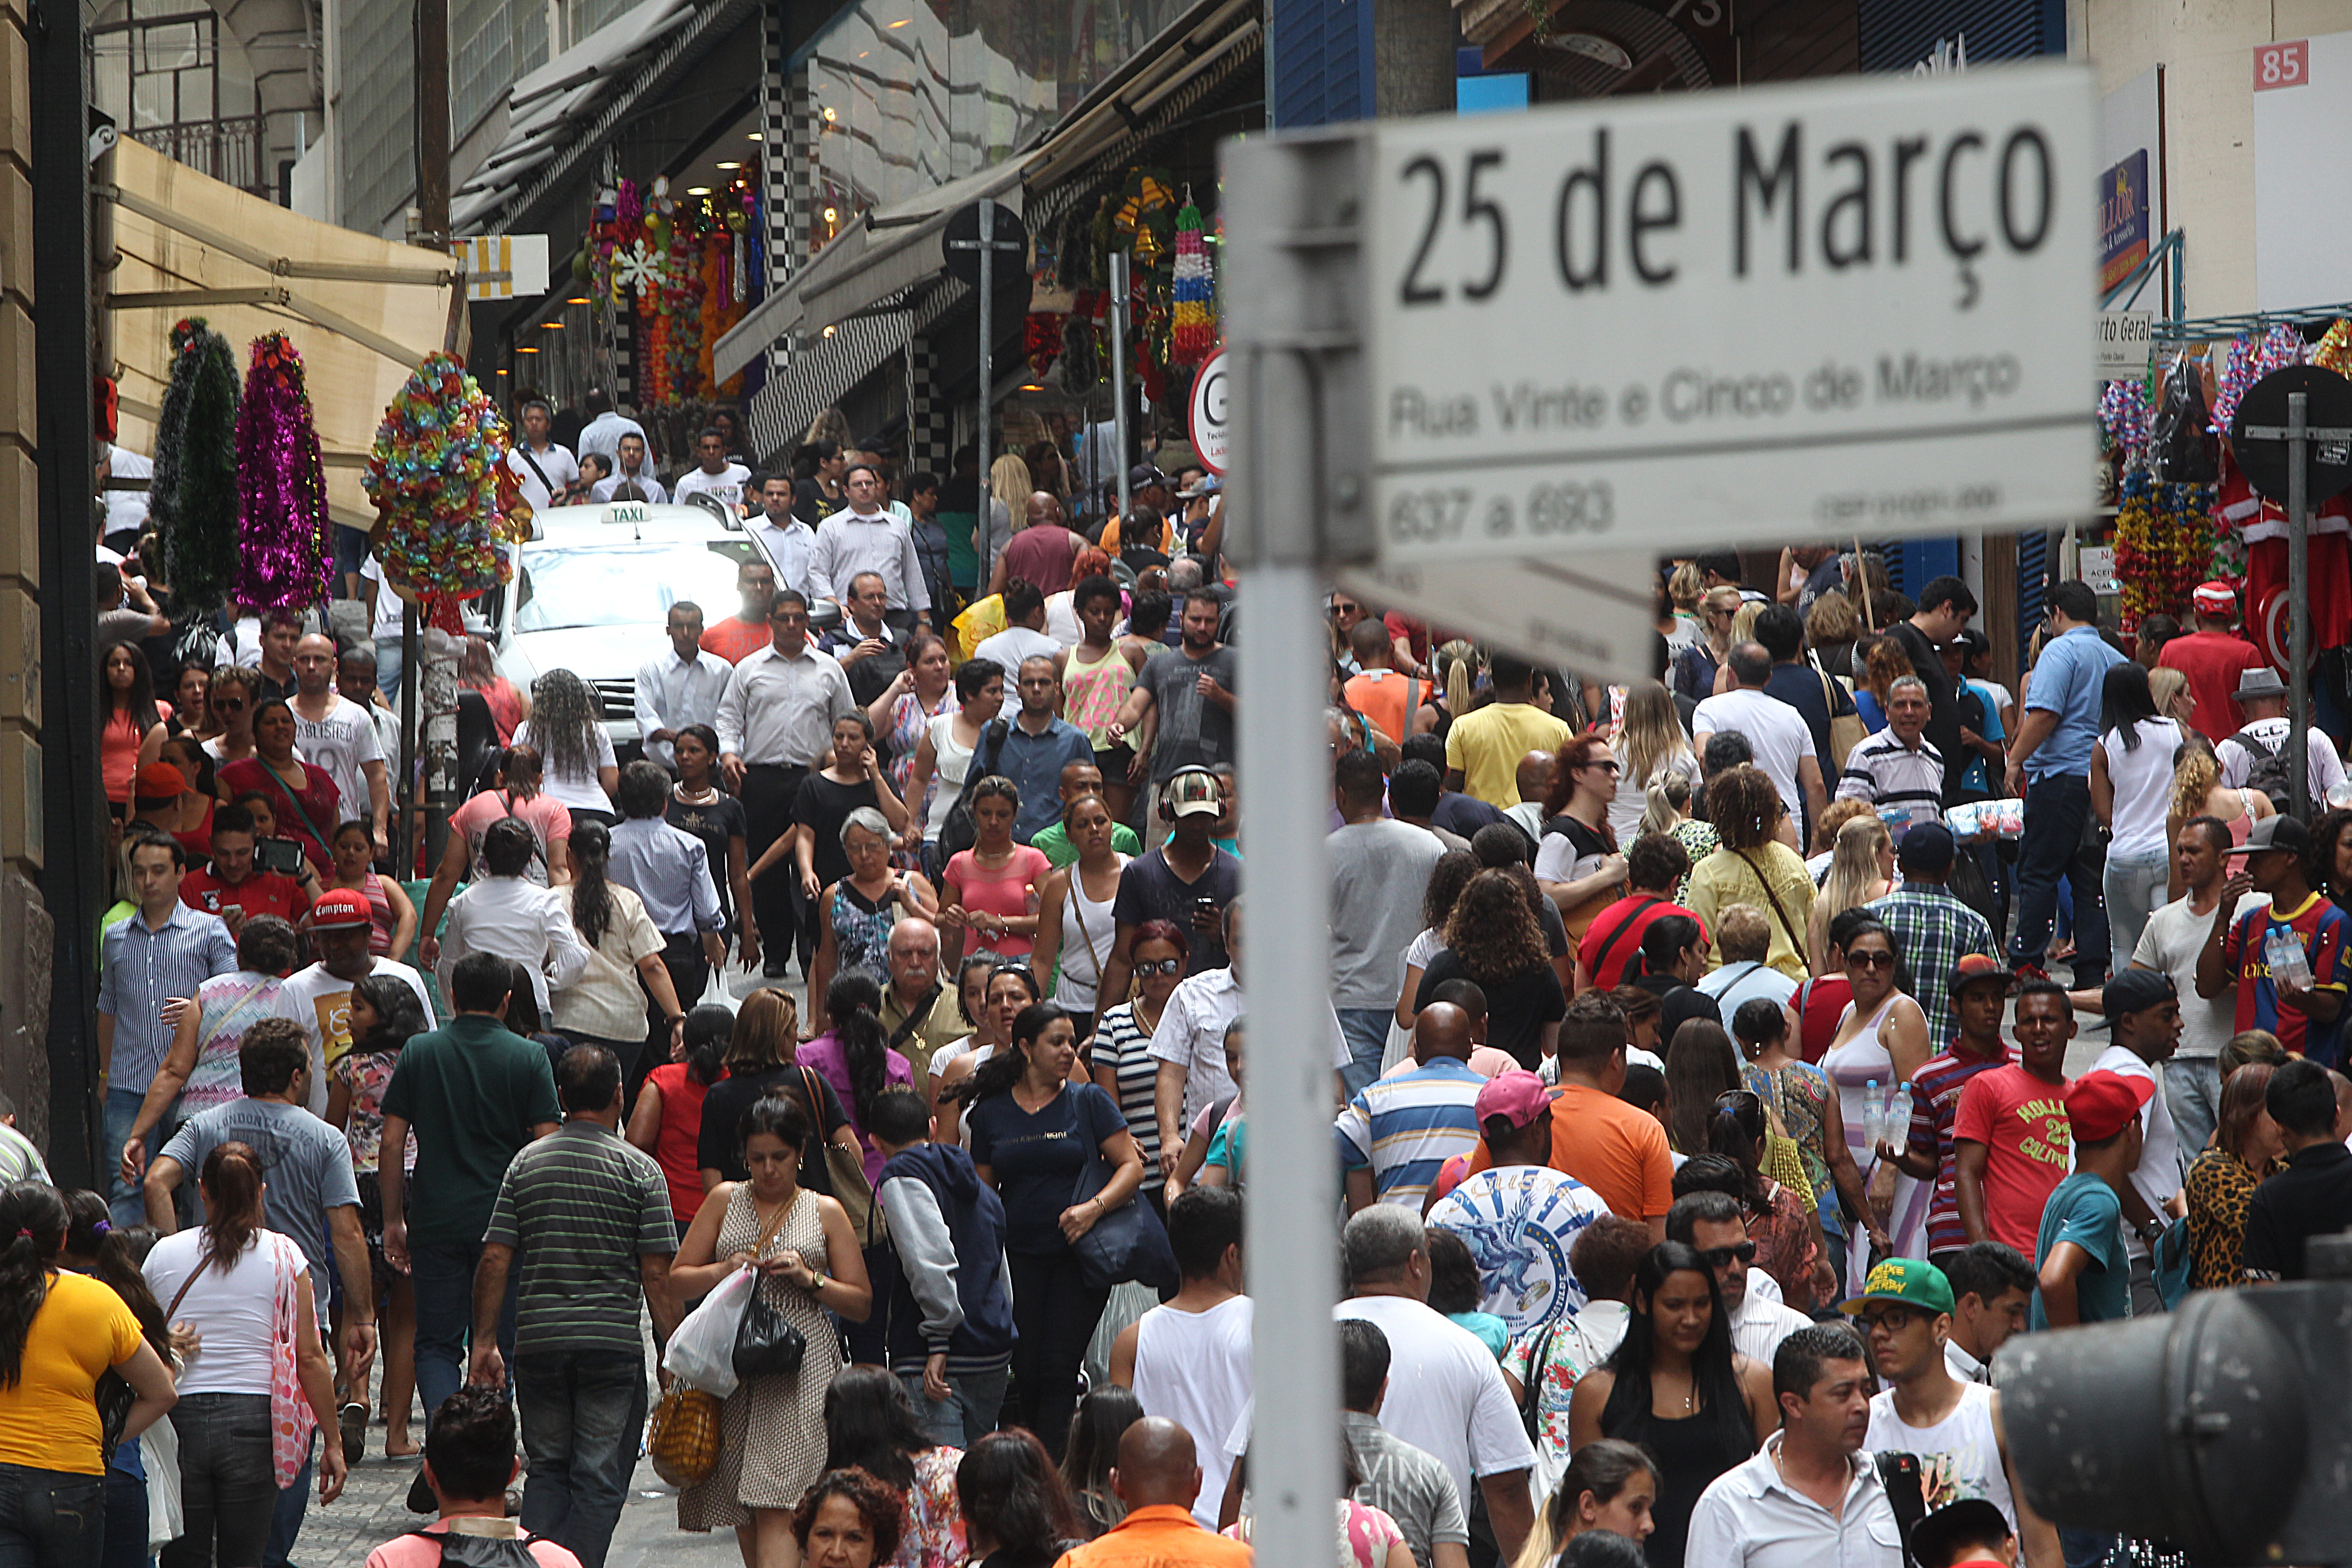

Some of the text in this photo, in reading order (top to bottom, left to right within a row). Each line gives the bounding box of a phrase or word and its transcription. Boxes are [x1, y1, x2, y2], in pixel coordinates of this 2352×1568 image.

[2262, 47, 2301, 84] 85
[1397, 115, 2056, 310] 25 de Março
[2120, 314, 2151, 342] Geral
[1387, 349, 2020, 438] Rua Vinte e Cinco de Março
[611, 507, 643, 523] TAXI
[1388, 478, 1614, 542] 637 a 693
[1065, 664, 1129, 695] HOT
[315, 902, 355, 917] Compton
[216, 1112, 262, 1130] LONDON
[264, 1117, 314, 1147] CALLING
[1041, 1130, 1068, 1140] Jeans
[1548, 1274, 1567, 1321] MATILDE
